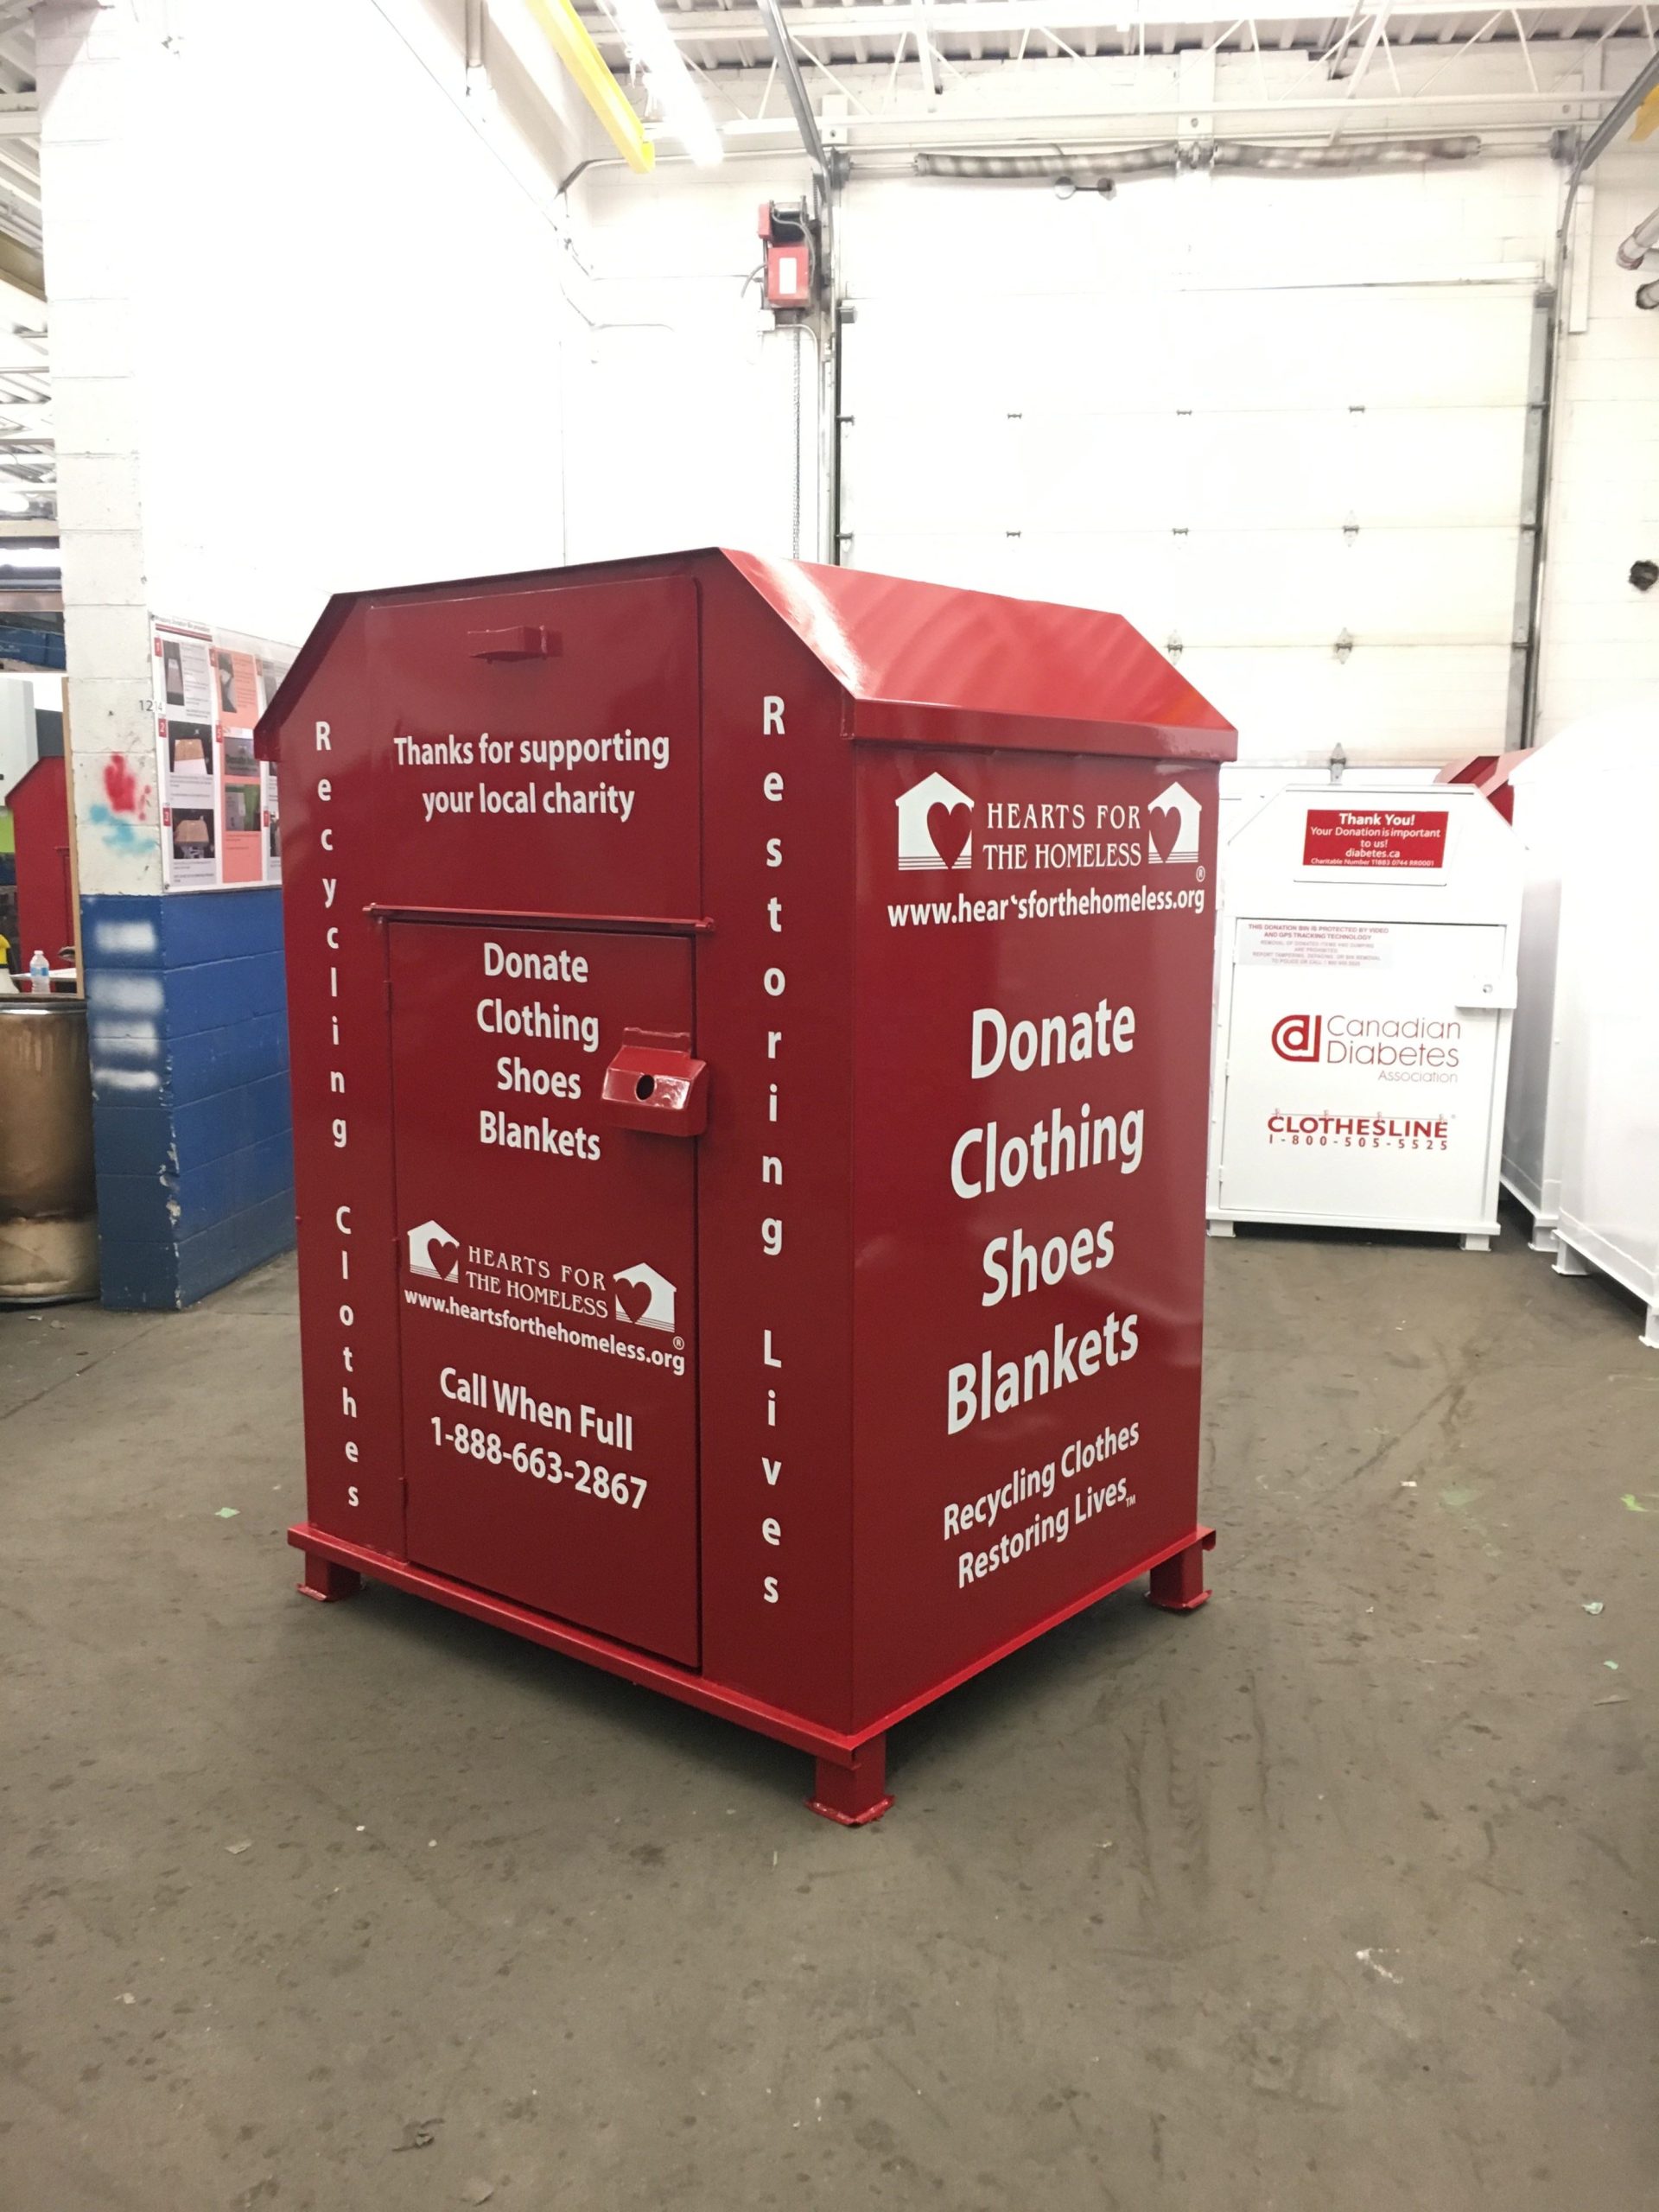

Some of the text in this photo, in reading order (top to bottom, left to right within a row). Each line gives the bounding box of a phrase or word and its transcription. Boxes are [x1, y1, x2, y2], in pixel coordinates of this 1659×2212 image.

[394, 730, 670, 770] Thanks for supporting
[423, 782, 635, 822] your local charity
[987, 803, 1141, 830] HEARTS FOR
[1339, 813, 1415, 826] Thank You!
[1311, 826, 1441, 839] Your Donation is important
[1345, 849, 1401, 858] diabetes.ca
[1360, 839, 1388, 849] to us!
[983, 842, 1141, 870] THE HOMELESS
[887, 885, 1205, 927] www.hearsforthehomeless.org
[485, 942, 588, 983] Donate
[477, 999, 599, 1052] Clothing
[971, 998, 1135, 1079] Donate
[1326, 1014, 1461, 1039] Canadian
[1326, 1040, 1459, 1068] Diabetes
[498, 1057, 582, 1100] Shoes
[1377, 1070, 1458, 1084] Association
[480, 1110, 601, 1160] Blankets
[1268, 1116, 1448, 1138] CLOTHESLINE
[950, 1103, 1144, 1199] Clothing
[468, 1245, 606, 1291] HEARTS FOR
[982, 1221, 1114, 1306] Shoes
[466, 1271, 607, 1319] THE HOMELESS
[404, 1289, 685, 1376] www.heartsforthehomeless.org
[948, 1312, 1138, 1435] Blankets
[440, 1367, 632, 1452] Call When Full
[430, 1416, 648, 1510] 1-888-663-2867
[944, 1421, 1139, 1541] Recycling Clothes
[959, 1507, 1069, 1588] Restoring
